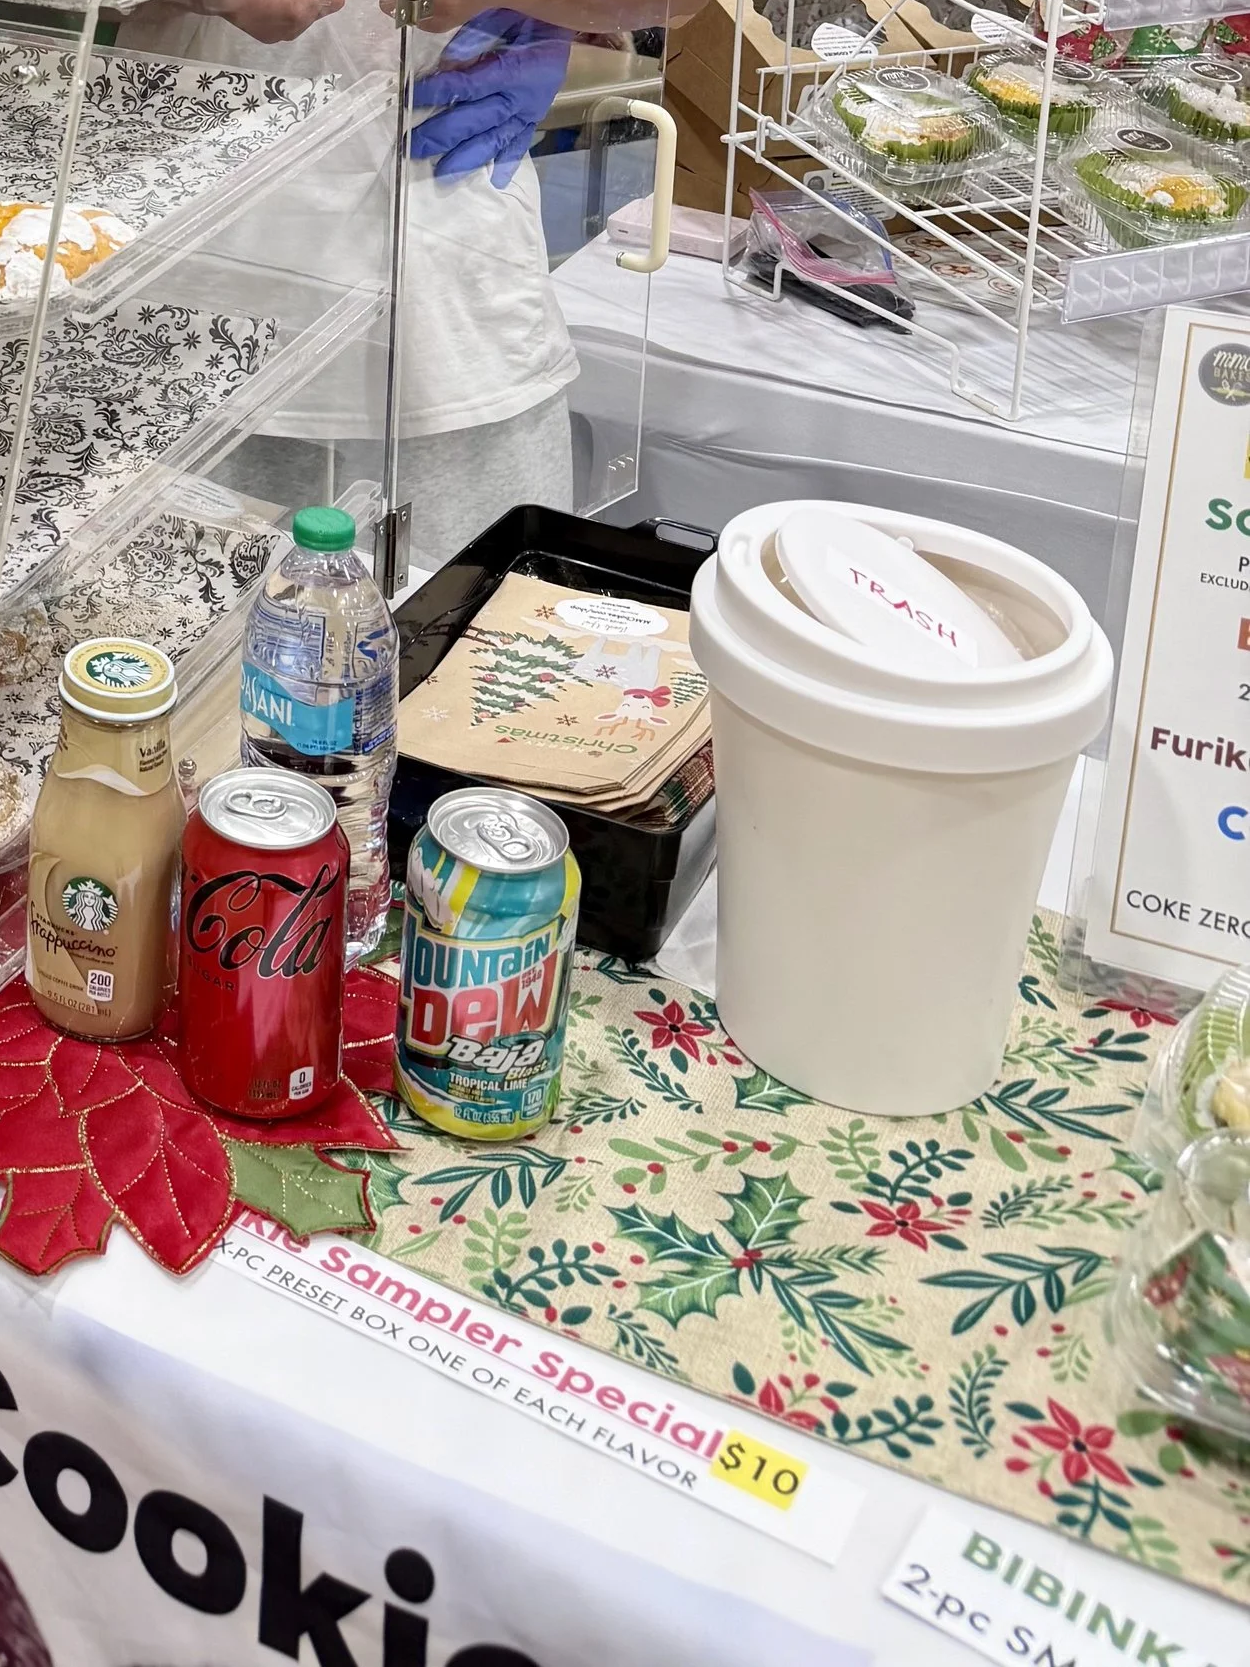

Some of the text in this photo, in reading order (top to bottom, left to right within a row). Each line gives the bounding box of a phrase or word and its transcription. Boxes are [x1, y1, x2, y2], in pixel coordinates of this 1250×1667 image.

[850, 568, 957, 647] TRASH
[1200, 572, 1250, 592] EXCLUD
[1150, 726, 1250, 773] Furik
[186, 857, 341, 979] Cola
[1126, 890, 1191, 922] COKE
[90, 973, 111, 987] 200
[448, 1035, 545, 1074] Baja
[449, 1072, 528, 1091] TROPICAL LIME
[214, 1236, 698, 1489] X-PC PRESET BOX ONE OF EACH FLAVOR
[320, 1245, 522, 1355] Sampler
[719, 1442, 799, 1496] $10
[901, 1563, 992, 1634] 2-pc
[961, 1530, 1185, 1667] BIBINK
